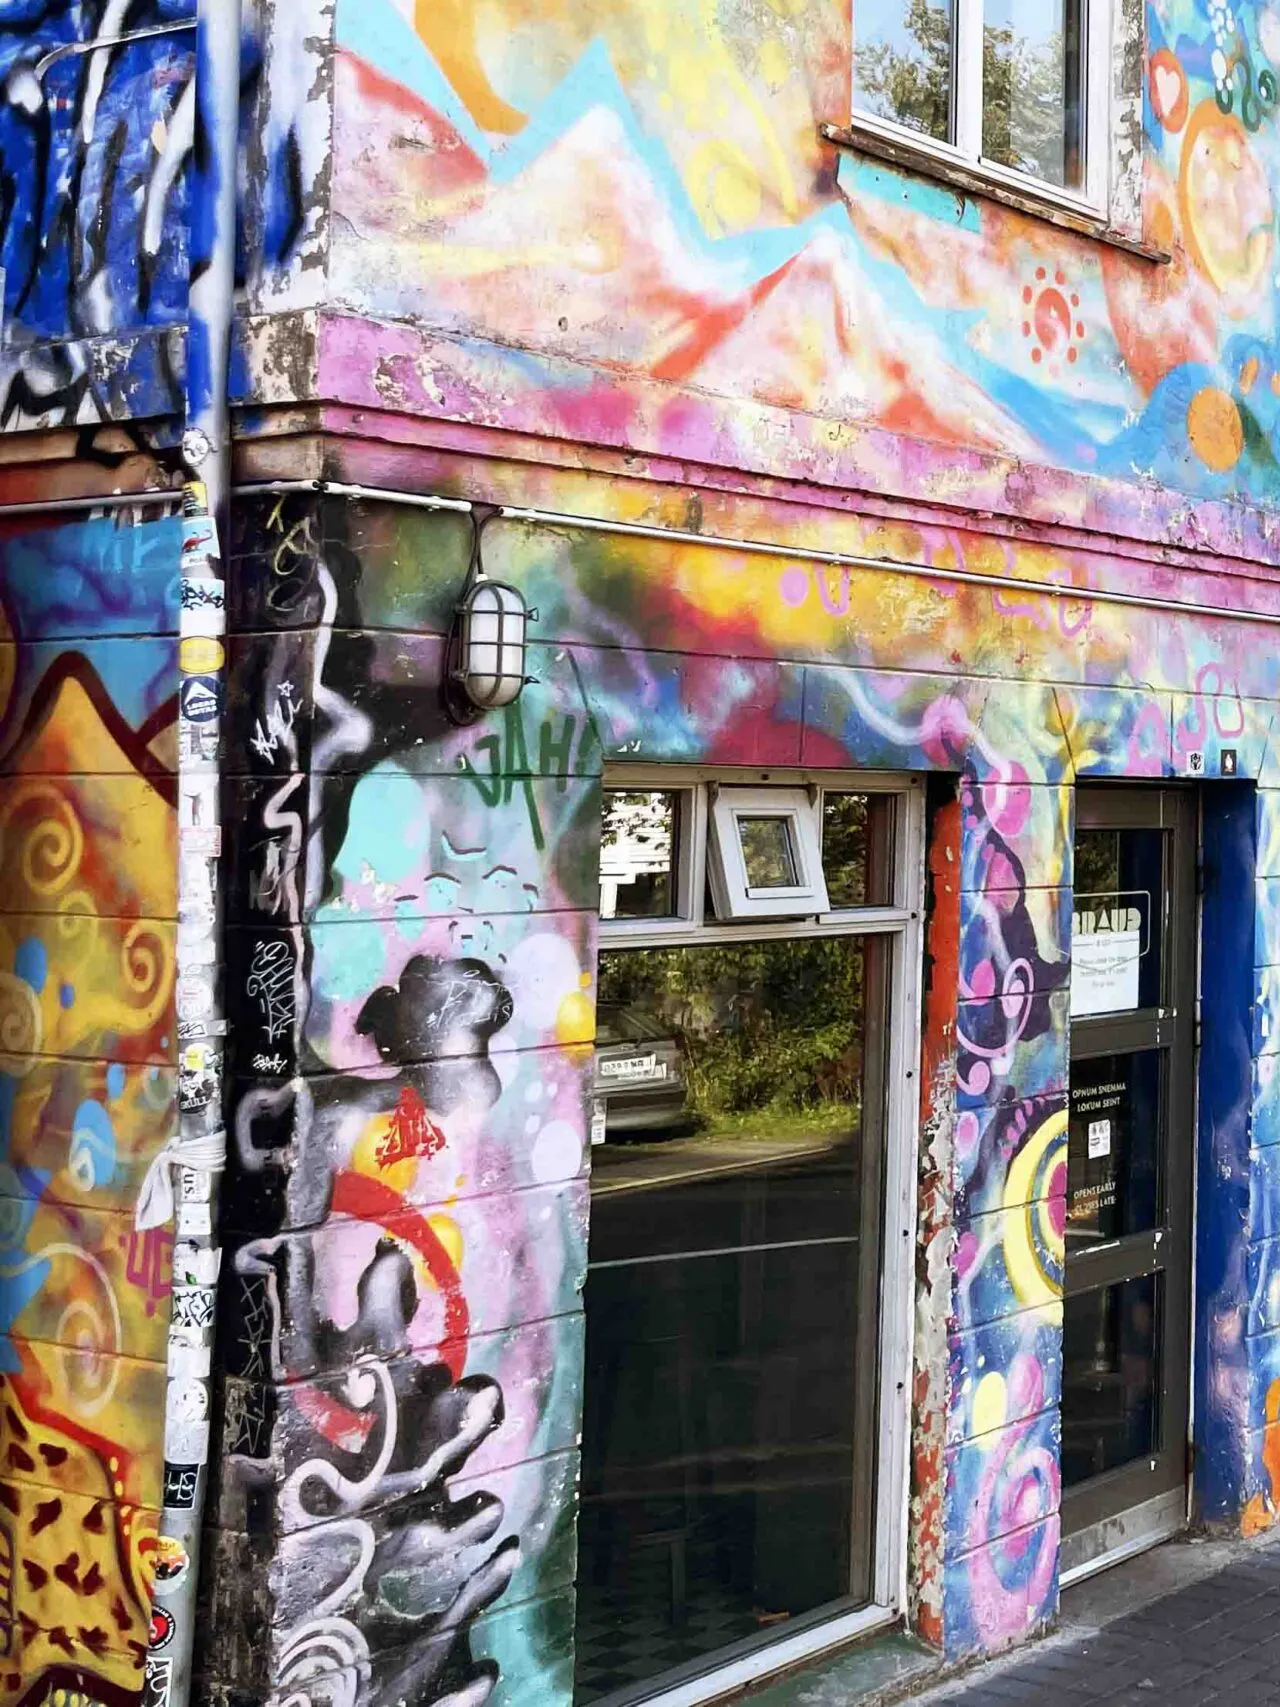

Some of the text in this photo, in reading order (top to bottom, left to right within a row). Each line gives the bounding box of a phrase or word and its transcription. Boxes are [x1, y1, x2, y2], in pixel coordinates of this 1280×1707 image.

[1072, 1088, 1098, 1099] OPNUM
[1076, 1097, 1121, 1113] LOKUM SEINT
[1073, 1186, 1096, 1200] OPENS
